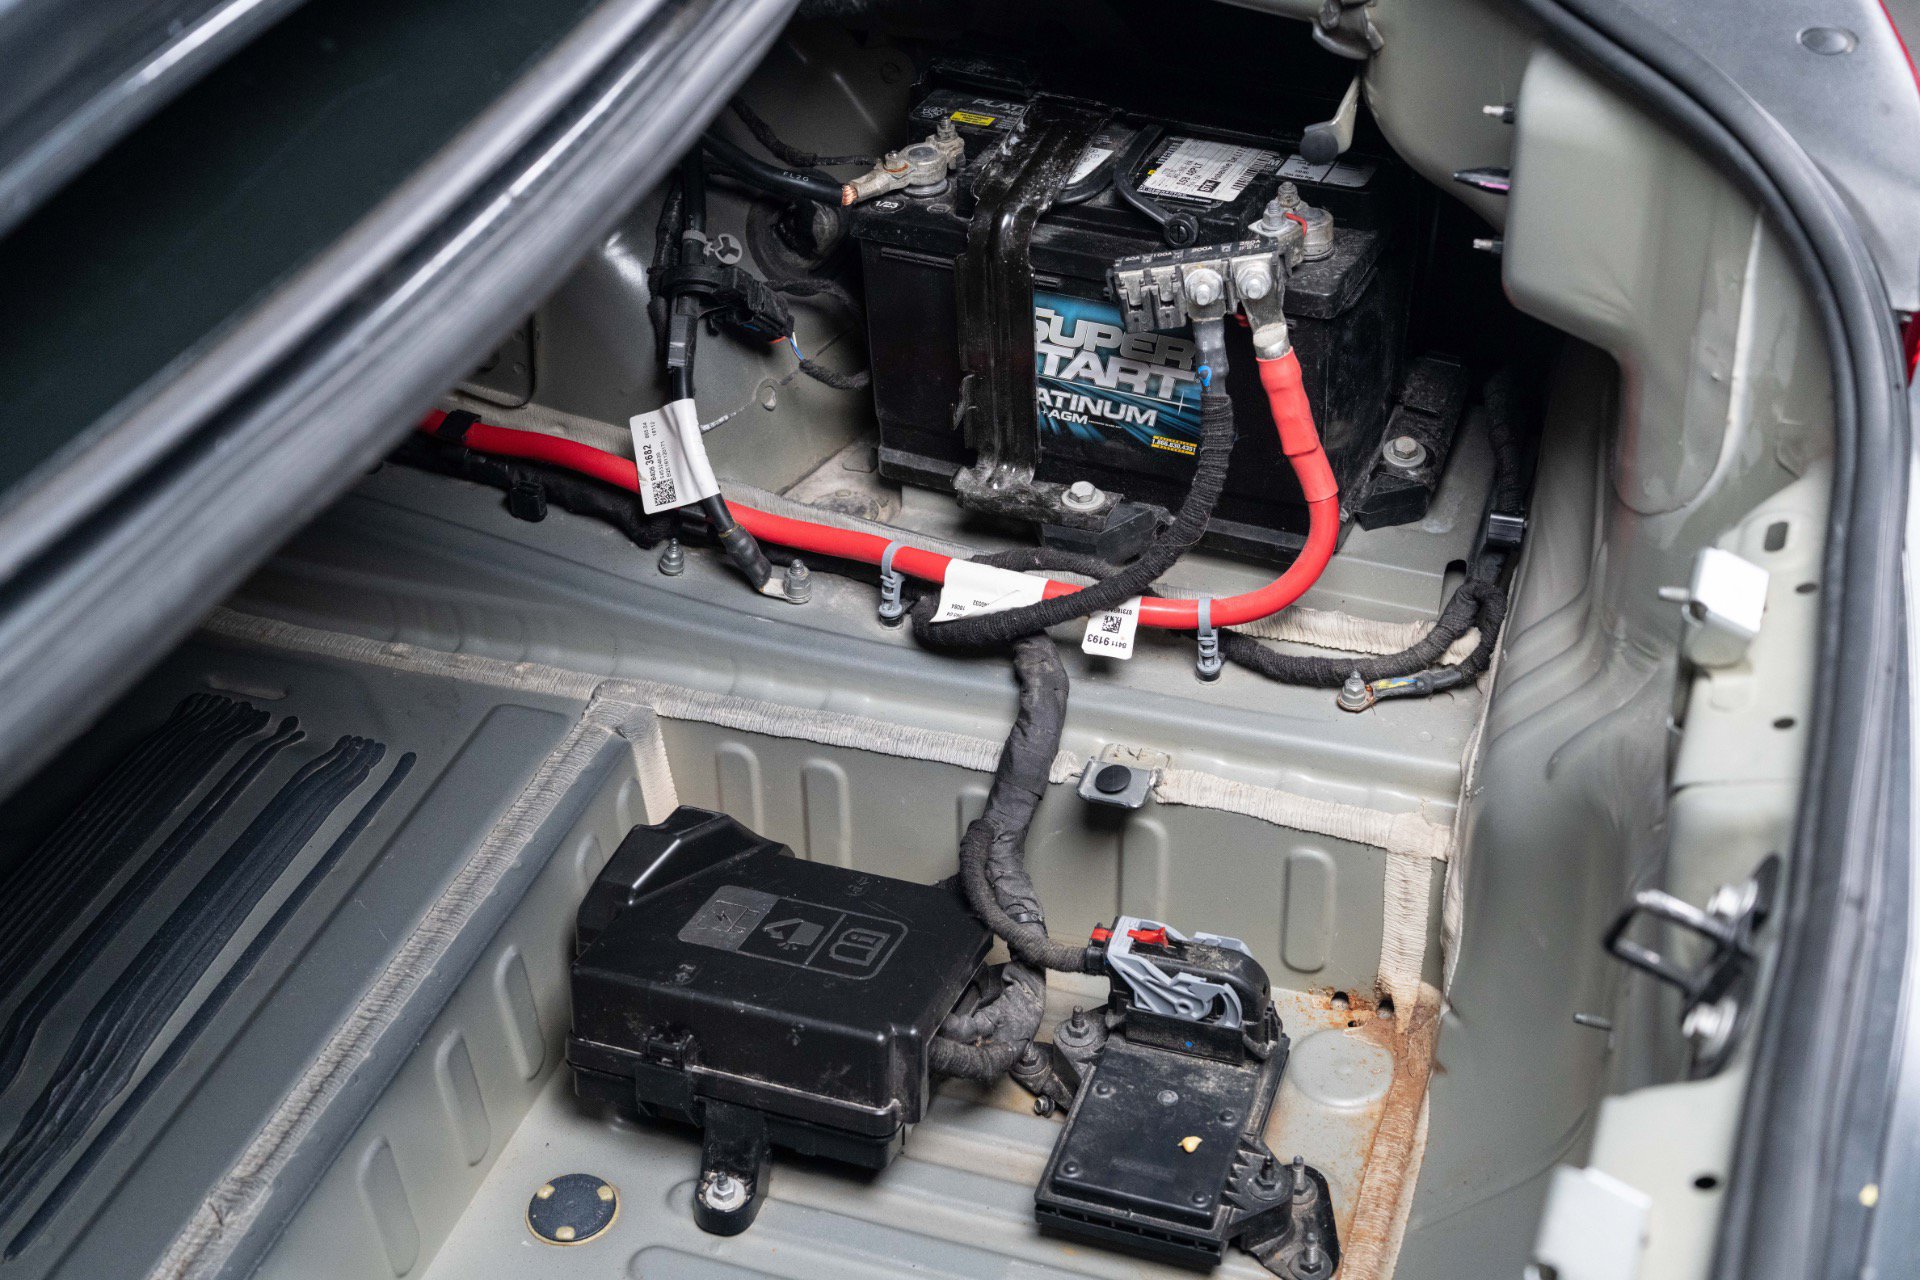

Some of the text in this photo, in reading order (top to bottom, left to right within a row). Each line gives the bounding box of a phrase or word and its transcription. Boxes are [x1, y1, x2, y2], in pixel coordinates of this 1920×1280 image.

[875, 200, 899, 208] 1/23
[1035, 342, 1196, 400] TART
[1037, 386, 1159, 427] ATINUM
[642, 443, 655, 466] 3682
[1087, 633, 1110, 646] 9193
